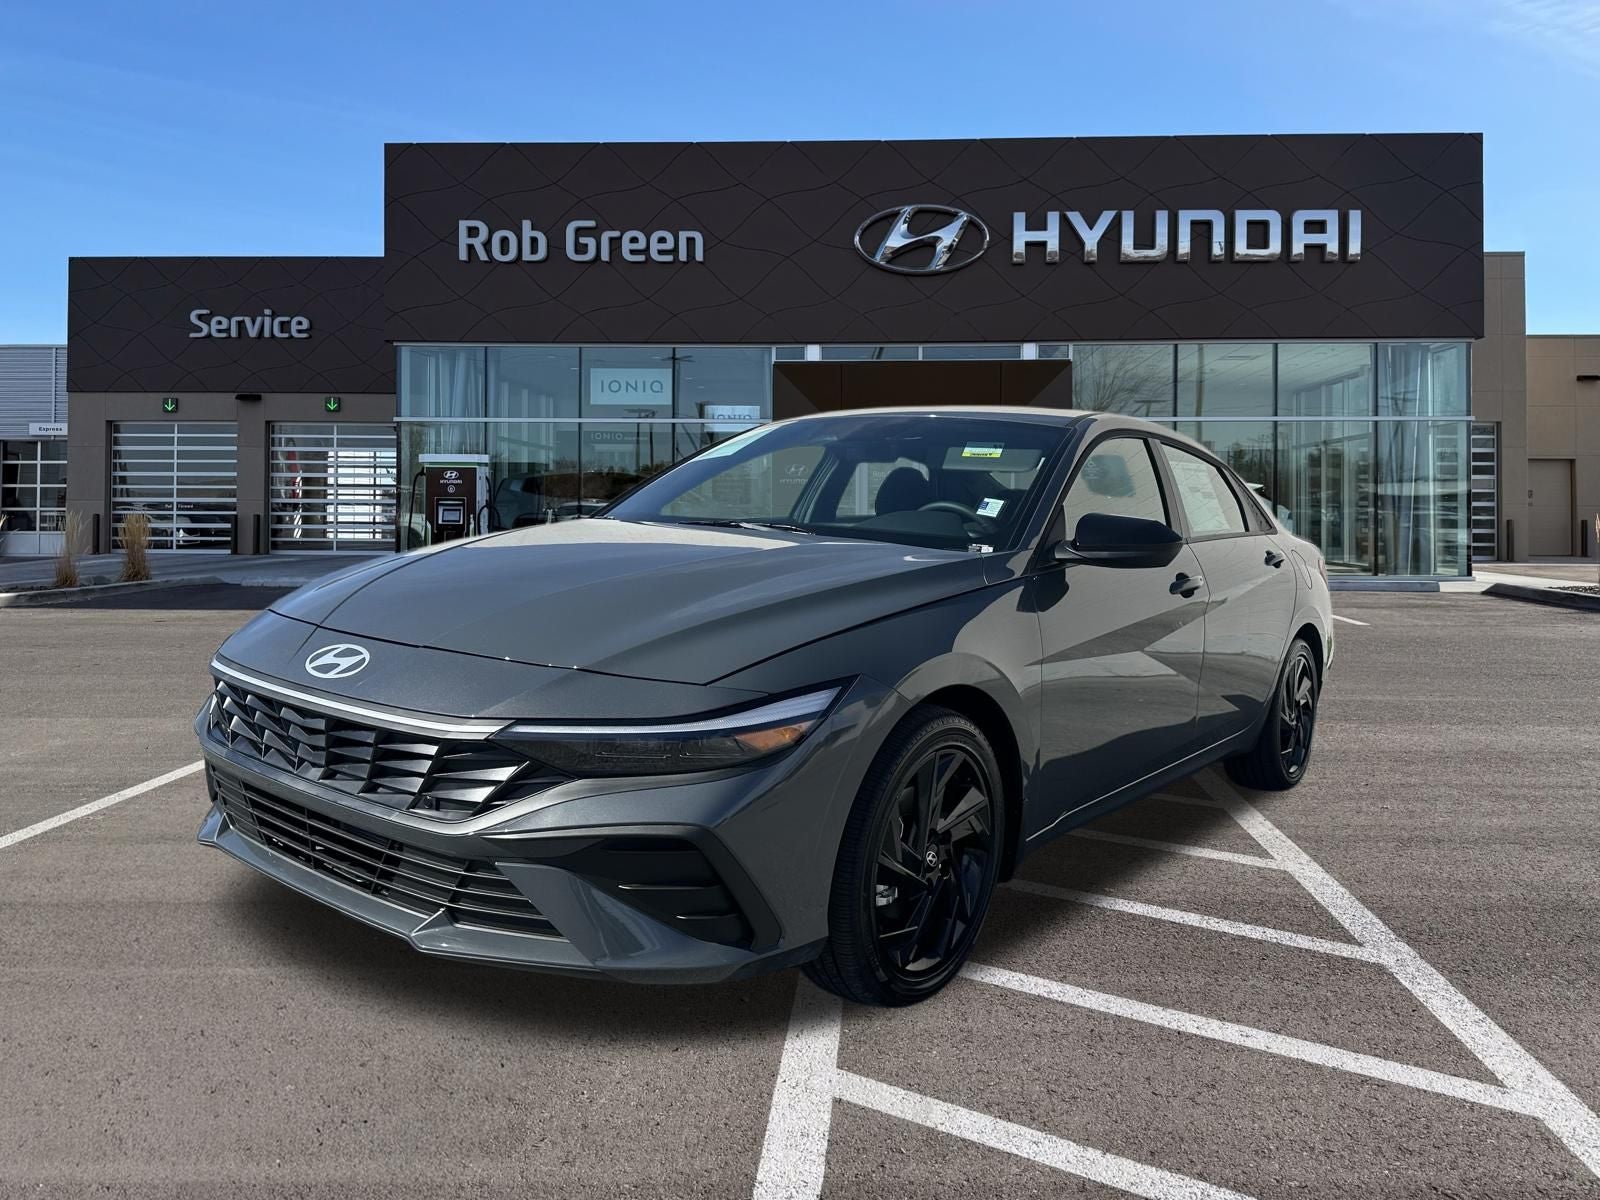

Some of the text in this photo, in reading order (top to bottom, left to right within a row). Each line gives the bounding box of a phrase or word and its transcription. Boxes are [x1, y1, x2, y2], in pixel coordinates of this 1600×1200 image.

[458, 219, 705, 263] Rob Green
[1011, 208, 1362, 264] HYUNDAI
[188, 308, 311, 339] Service
[600, 379, 664, 394] IONIQ
[591, 432, 624, 441] IONIQ
